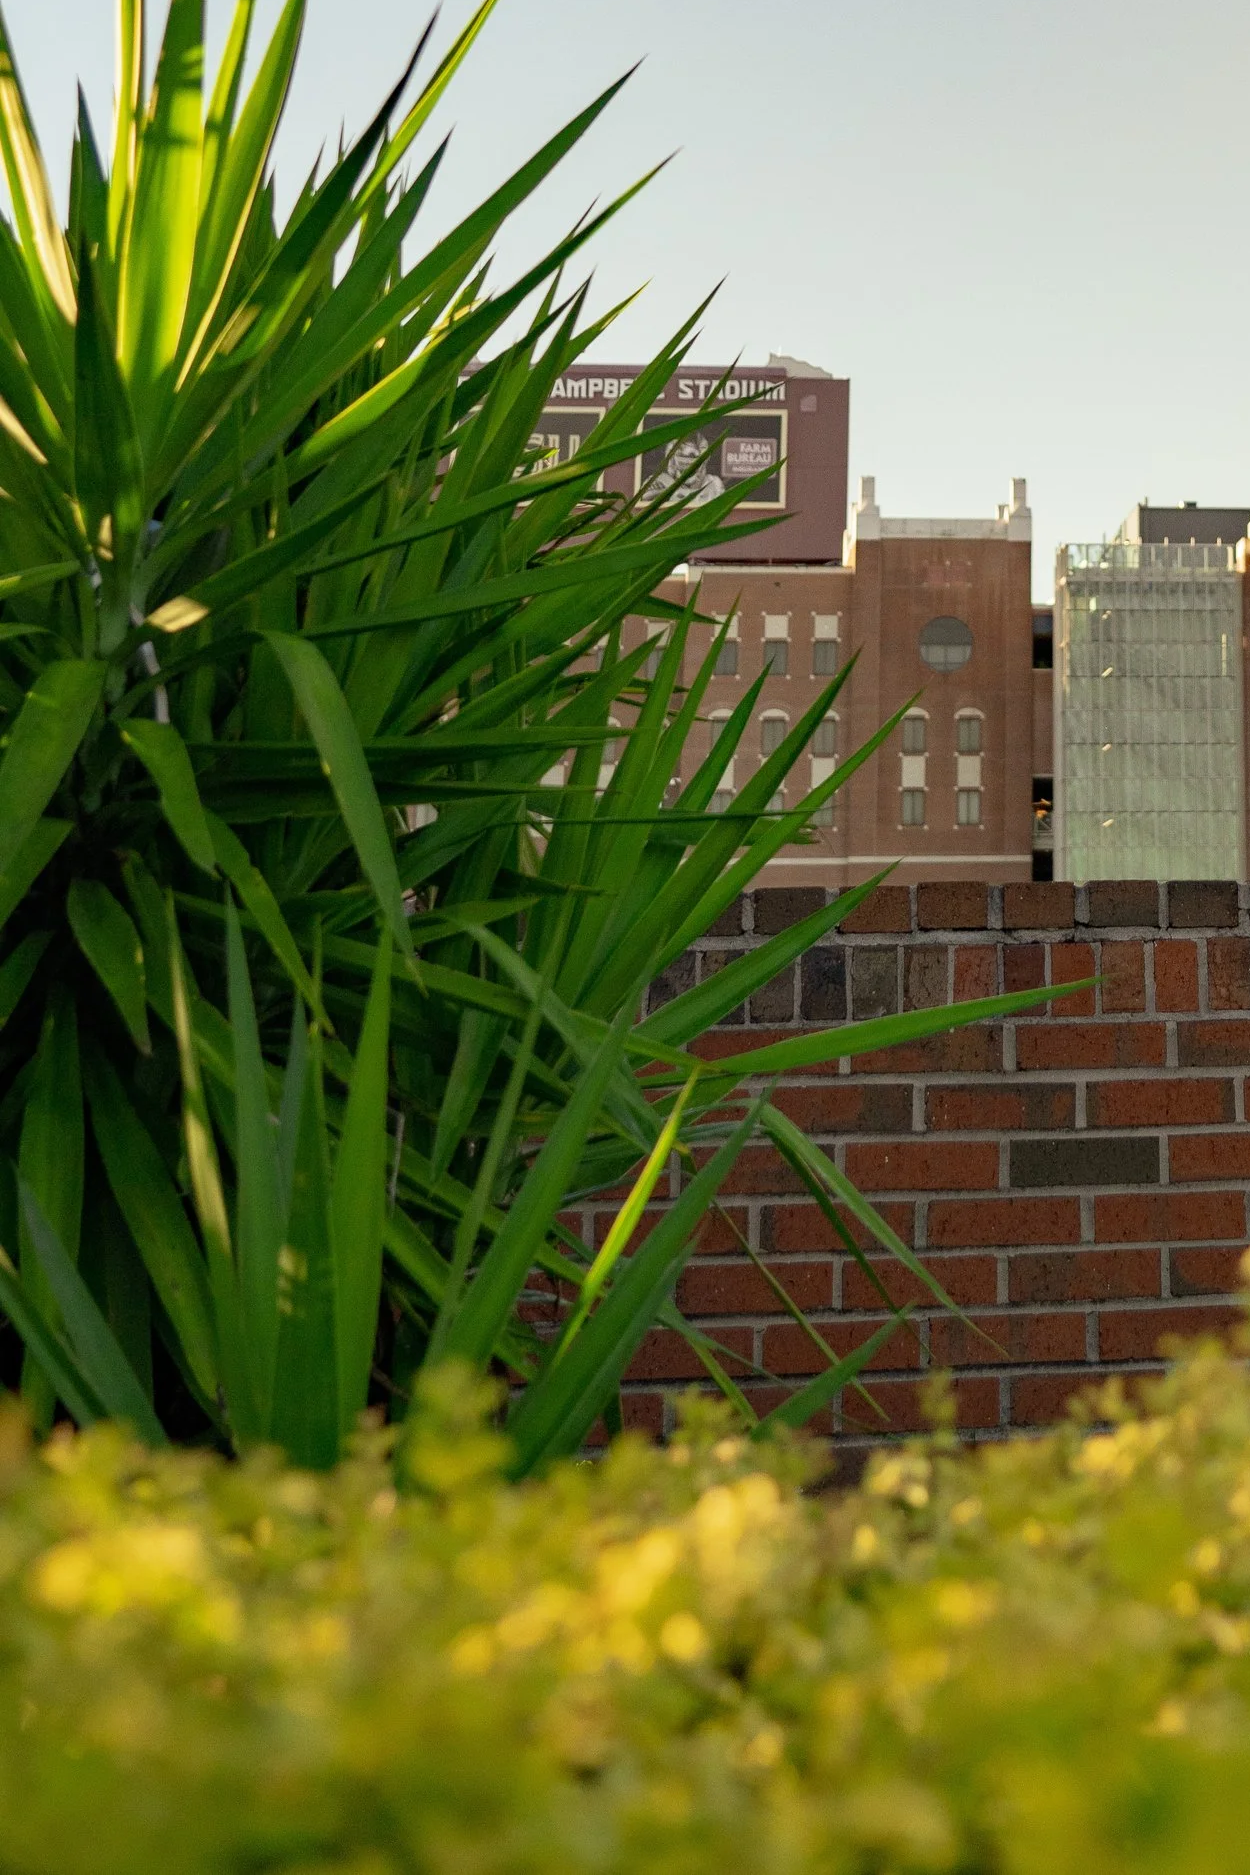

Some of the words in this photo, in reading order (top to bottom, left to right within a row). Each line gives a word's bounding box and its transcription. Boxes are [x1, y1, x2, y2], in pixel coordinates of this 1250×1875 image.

[550, 377, 665, 400] AMPBE
[740, 442, 771, 453] FARM
[727, 452, 771, 463] BUREAU
